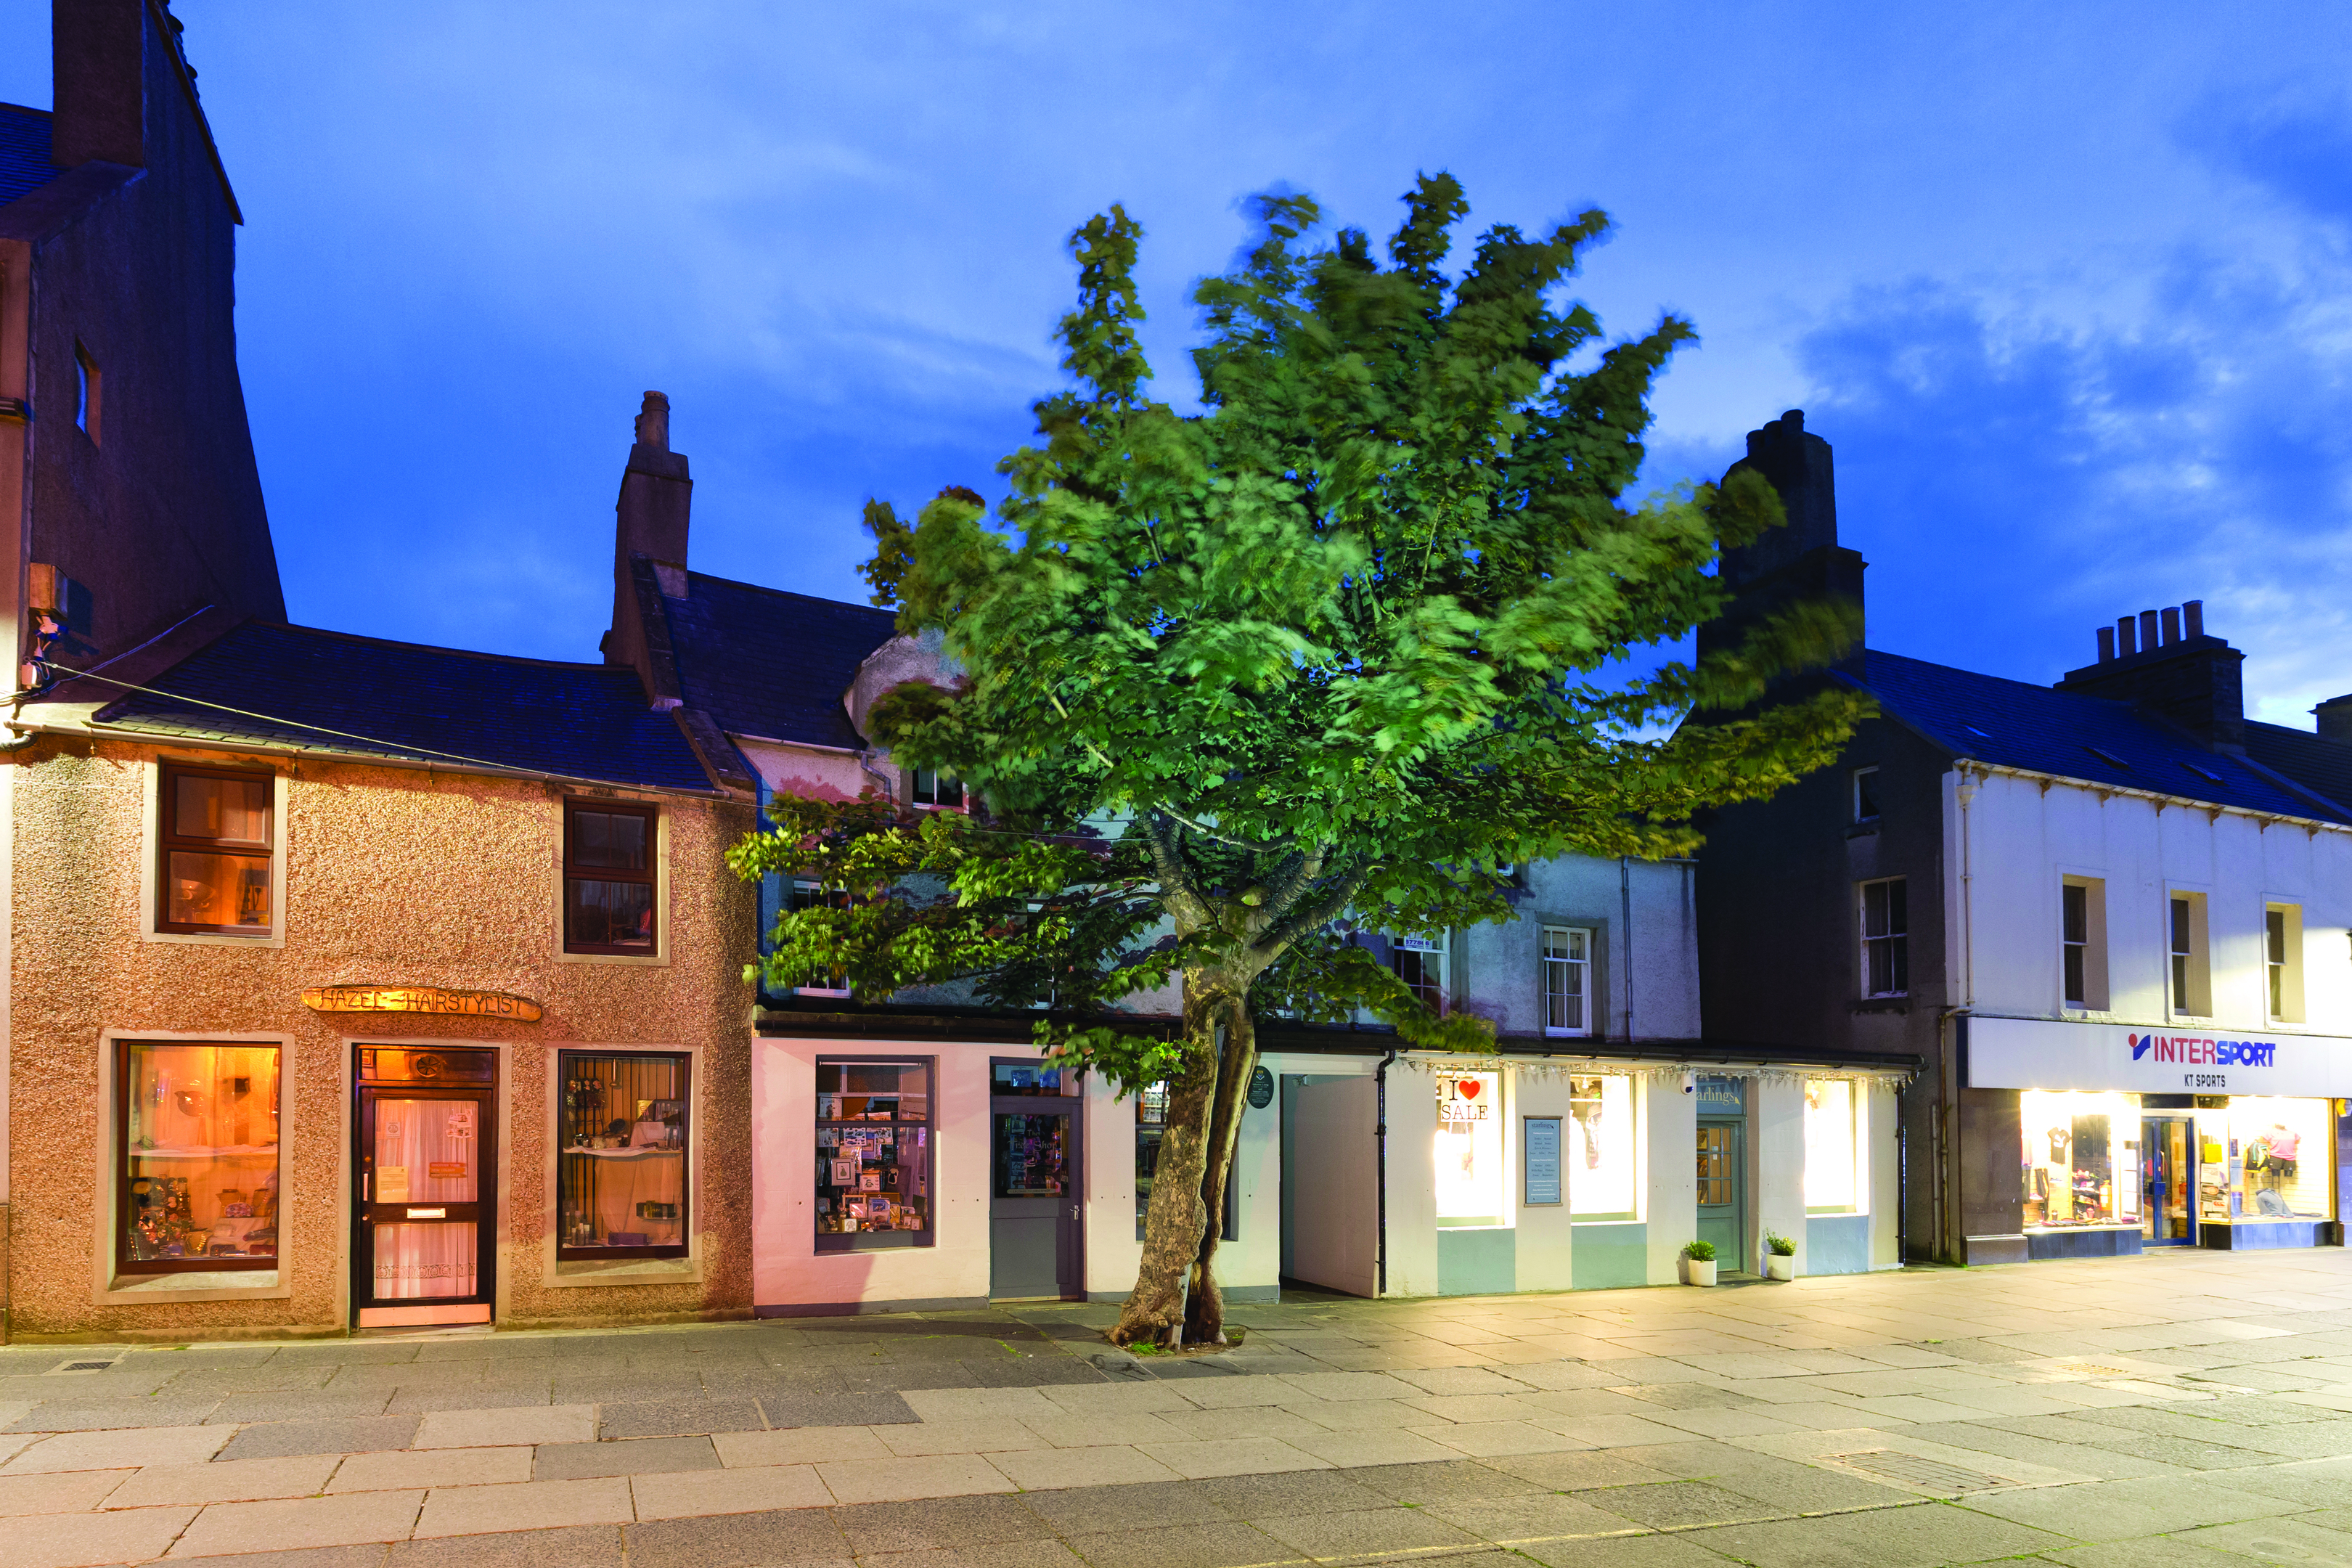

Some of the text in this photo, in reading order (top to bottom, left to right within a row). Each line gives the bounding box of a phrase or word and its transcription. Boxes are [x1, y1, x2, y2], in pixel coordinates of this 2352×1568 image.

[319, 989, 523, 1014] HAZEL HAIRSTYLIST
[2155, 1036, 2276, 1067] INTERSPORT
[2184, 1074, 2226, 1087] KT SPORTS
[1449, 1080, 1458, 1101] I
[1442, 1105, 1488, 1119] SALE
[1033, 1137, 1057, 1151] Shop
